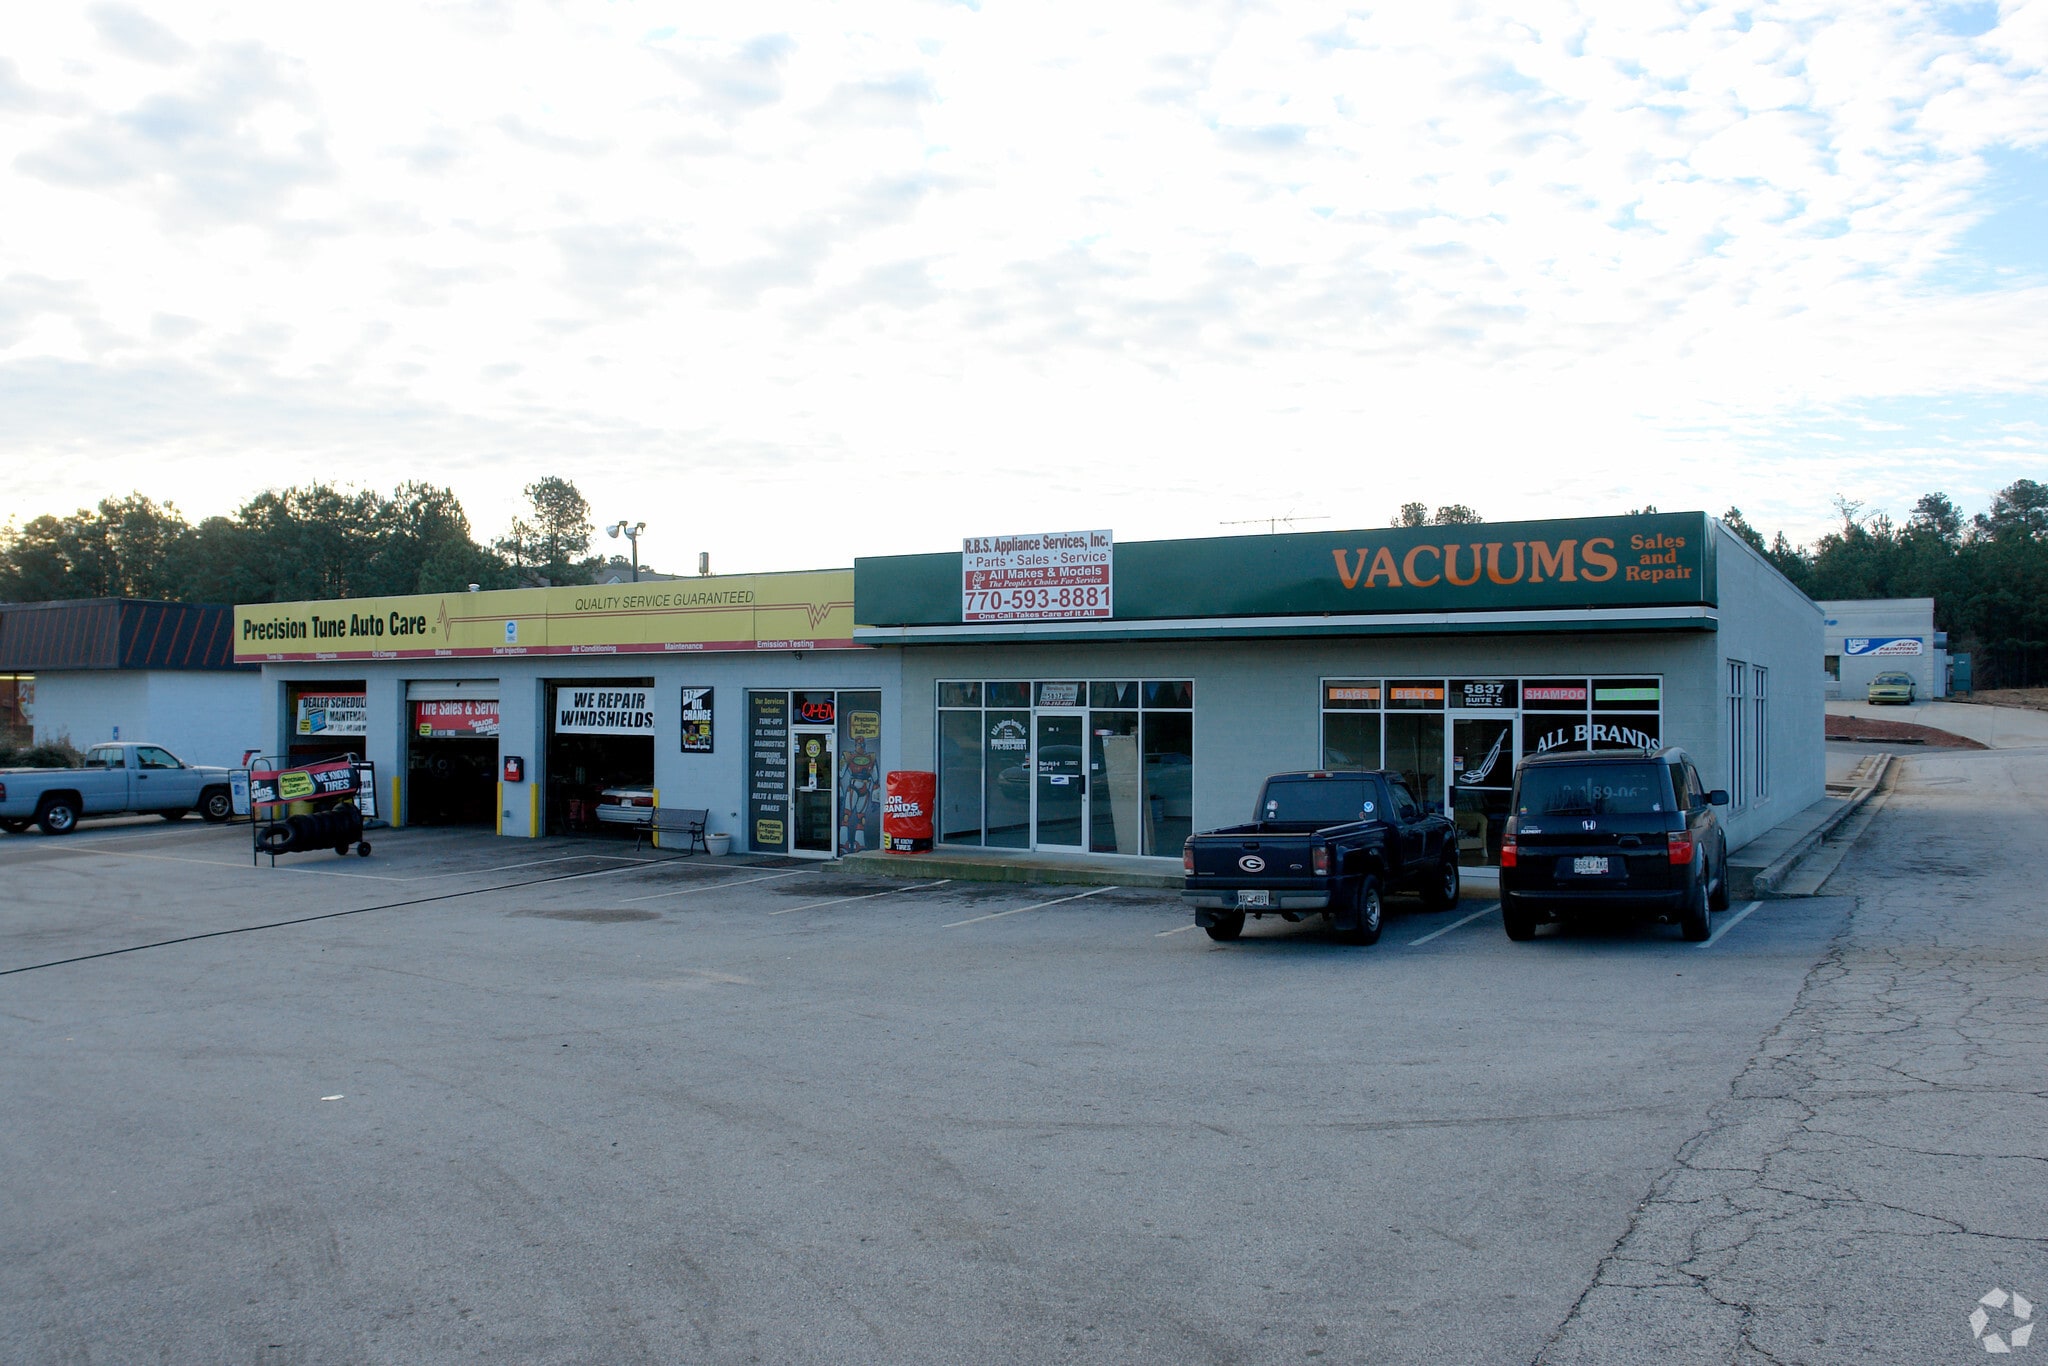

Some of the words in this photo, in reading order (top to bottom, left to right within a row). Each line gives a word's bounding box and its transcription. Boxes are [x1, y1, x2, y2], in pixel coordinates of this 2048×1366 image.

[965, 538, 992, 554] R.B.S.
[994, 536, 1040, 555] Appliance
[1042, 534, 1088, 551] Services,
[1090, 532, 1108, 547] Inc.
[1630, 532, 1686, 550] Sales
[976, 556, 1006, 568] Parts
[1016, 554, 1050, 566] Sales
[1060, 552, 1106, 564] Service
[1639, 549, 1676, 565] and
[1332, 537, 1618, 590] VACUUMS
[989, 570, 1004, 580] All
[1008, 568, 1044, 578] Makes
[1047, 568, 1056, 578] &
[1059, 566, 1102, 577] Models
[1625, 565, 1692, 584] Repair
[1004, 578, 1032, 588] People's
[1034, 578, 1058, 586] Choice
[575, 597, 622, 611] QUALITY
[622, 594, 672, 608] SERVICE
[673, 590, 754, 606] GUARANTEED
[965, 586, 1110, 611] 770-593-8881
[243, 617, 306, 640] Precision
[311, 615, 346, 639] Tune
[350, 613, 384, 637] Auto
[389, 611, 426, 636] Care
[580, 645, 616, 653] Conditioning
[664, 642, 704, 650] Maintenance
[757, 640, 786, 648] Emission
[788, 640, 814, 648] Testing
[380, 650, 396, 658] Change
[504, 647, 527, 655] Injection
[1336, 689, 1368, 700] BAGS
[1464, 684, 1504, 694] 5837
[1524, 689, 1586, 700] SHAMPOO
[303, 696, 330, 708] DEALER
[330, 697, 366, 708] SCHEDUL
[574, 692, 595, 708] WE
[597, 692, 646, 709] REPAIR
[692, 698, 703, 710] OIL
[764, 697, 785, 705] Services
[421, 701, 436, 716] Tire
[440, 701, 462, 716] Sales
[465, 701, 472, 716] &
[475, 701, 499, 716] Servi
[802, 702, 834, 720] OPEN
[682, 710, 712, 720] CHANGE
[1537, 728, 1568, 752] ALL
[1574, 724, 1660, 750] BRANDS
[314, 772, 328, 782] WE
[328, 770, 350, 781] KNOW
[323, 780, 350, 792] TIRES
[892, 810, 923, 818] available
